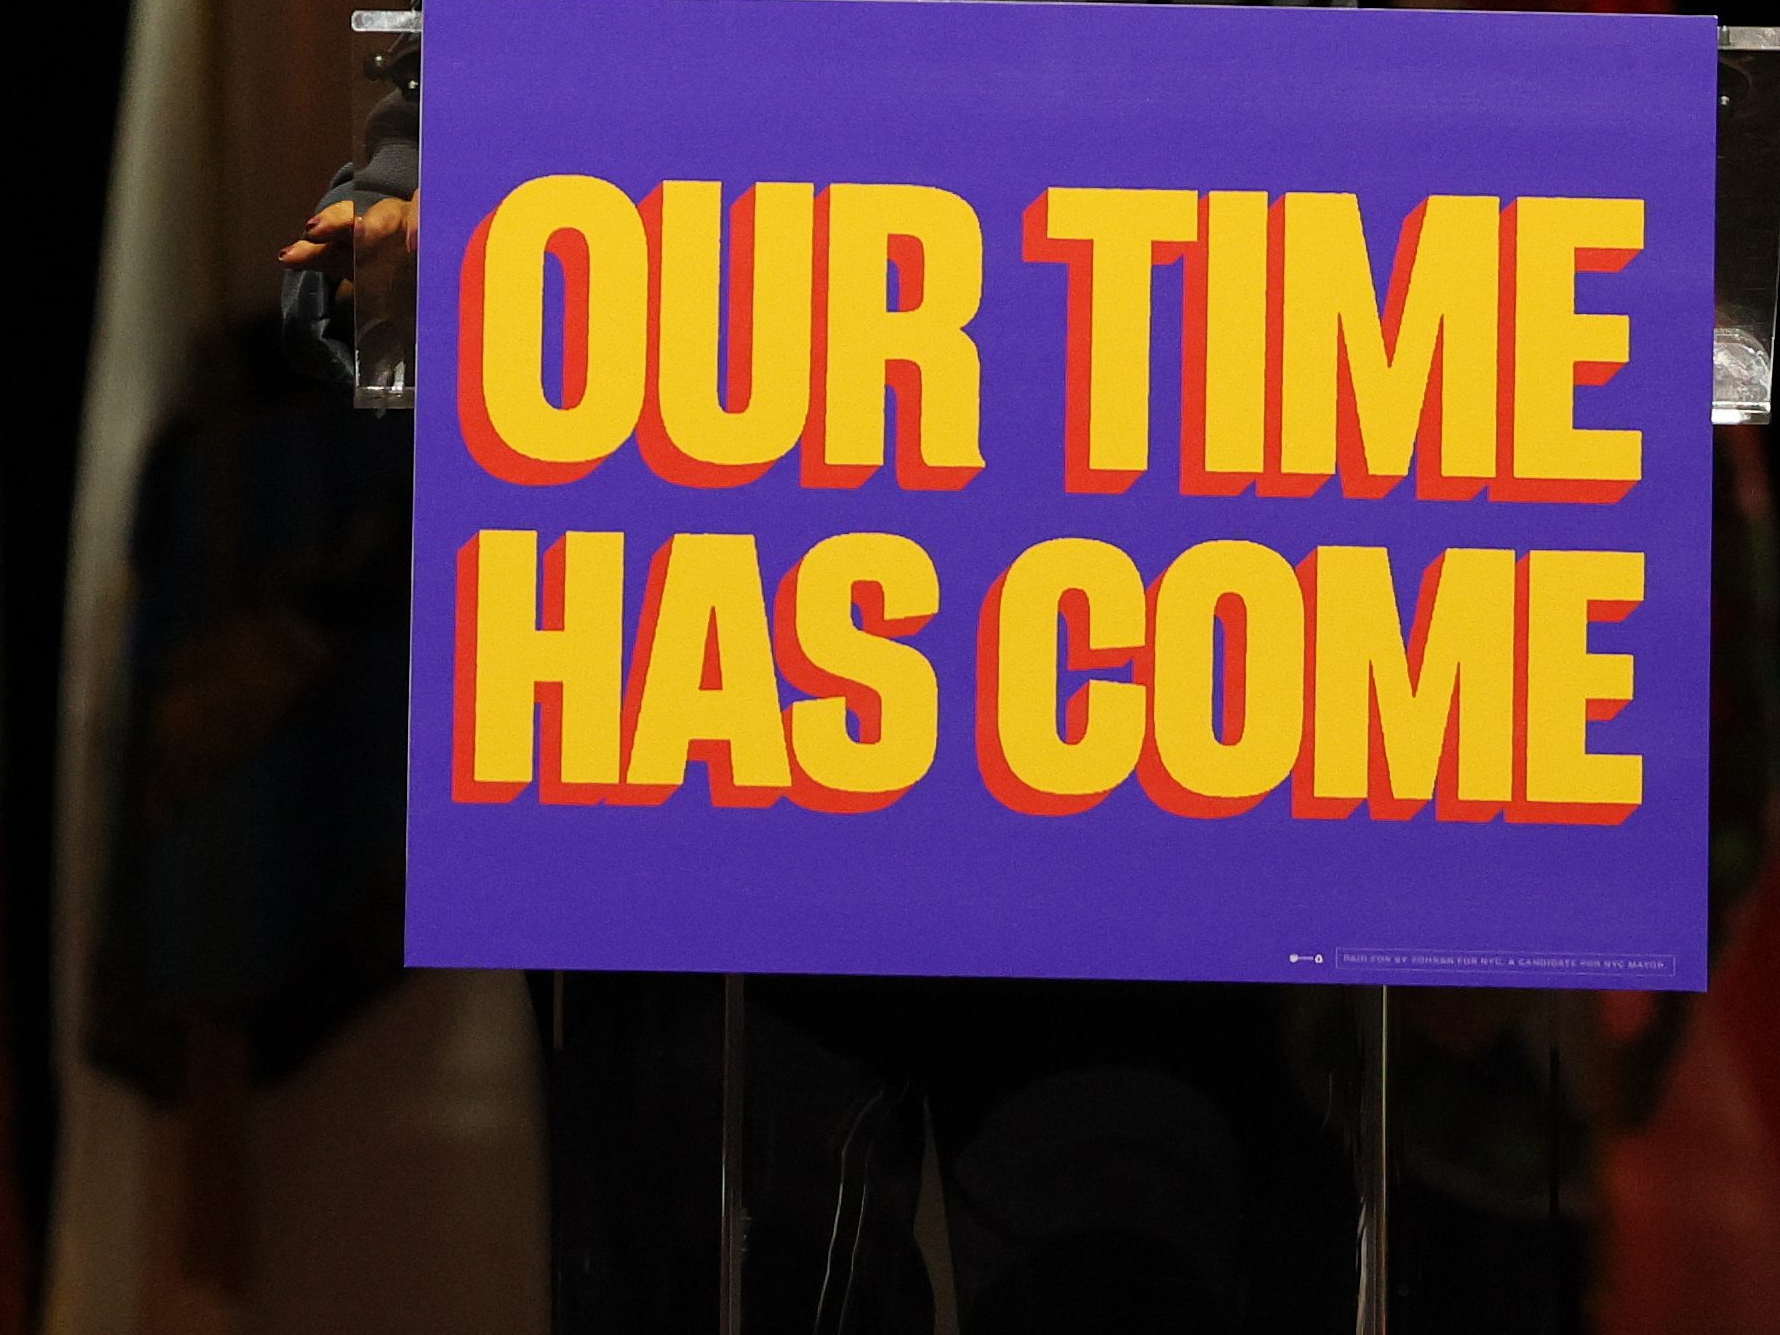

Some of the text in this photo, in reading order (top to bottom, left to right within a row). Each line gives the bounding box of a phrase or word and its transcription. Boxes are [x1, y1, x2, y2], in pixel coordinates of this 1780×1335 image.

[458, 175, 985, 492] OUR
[1023, 187, 1646, 505] TIME
[452, 530, 1646, 827] HAS COME
